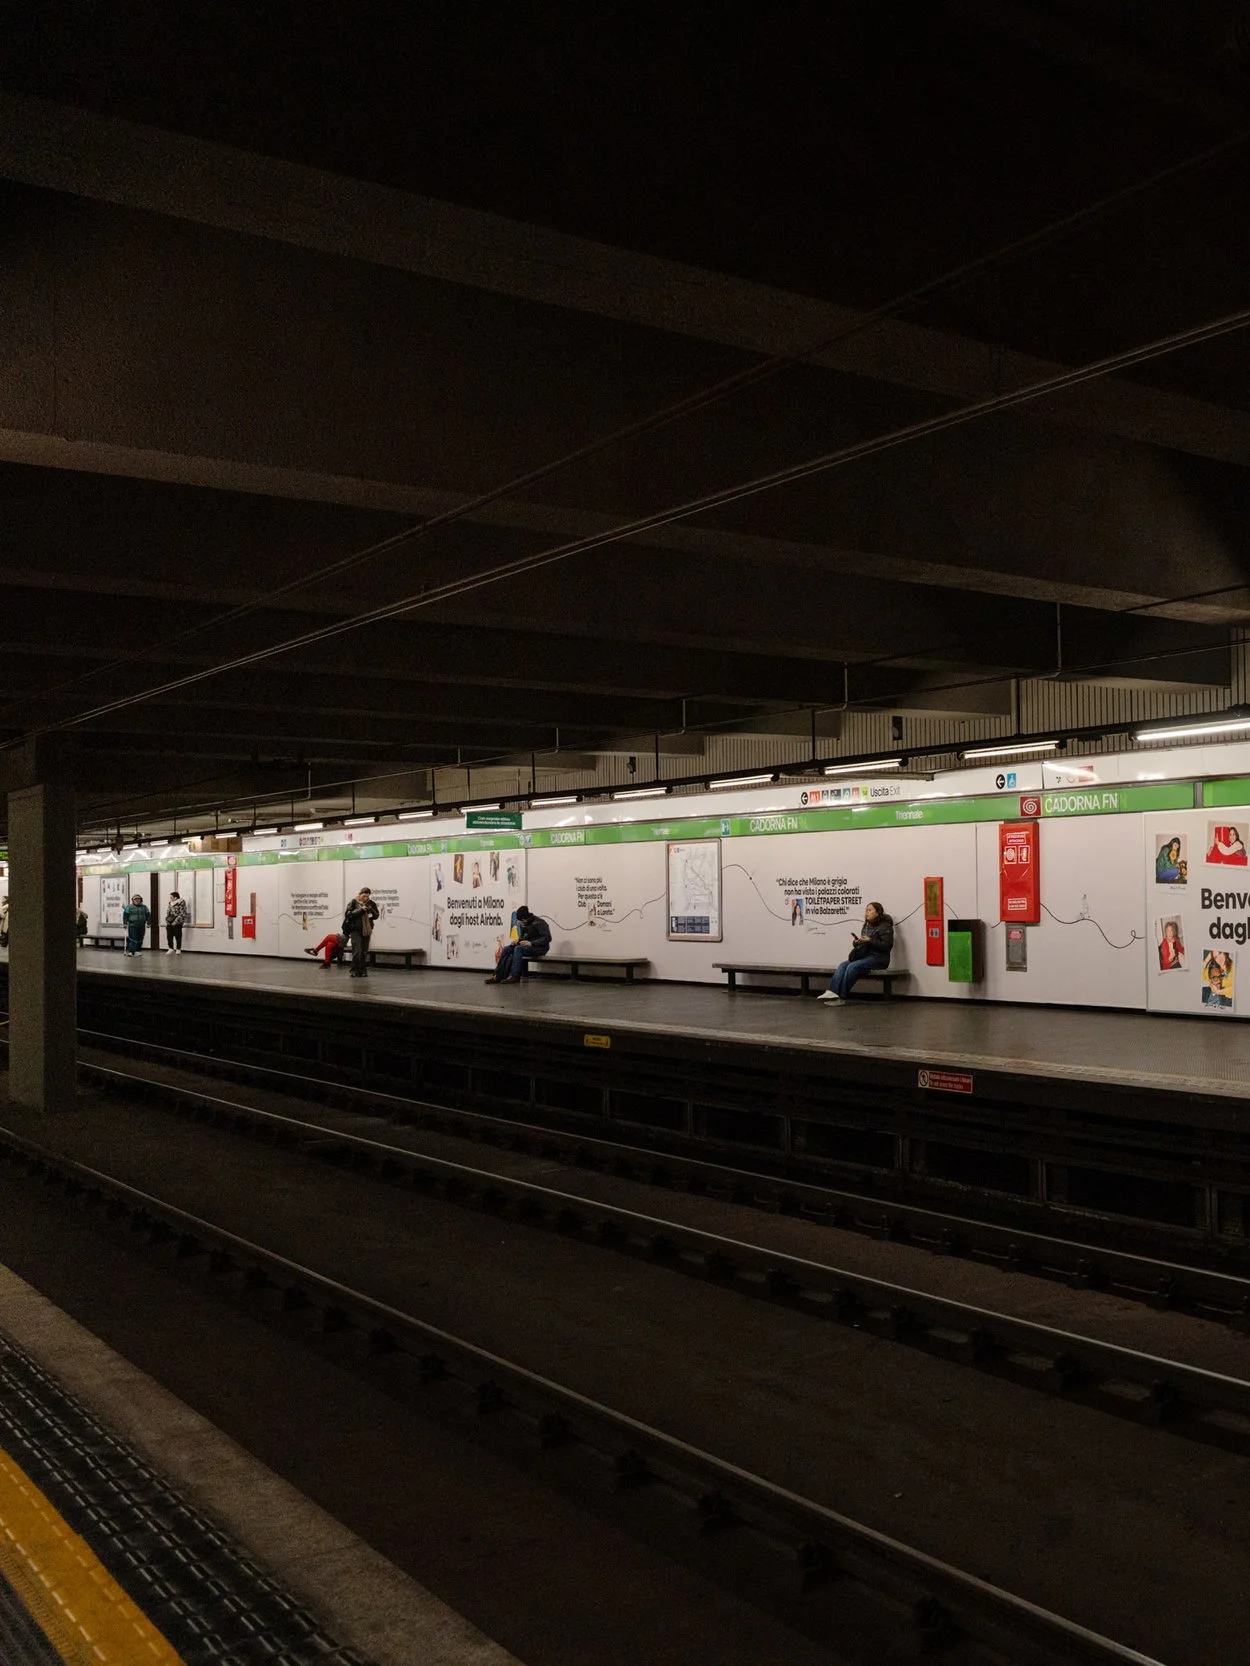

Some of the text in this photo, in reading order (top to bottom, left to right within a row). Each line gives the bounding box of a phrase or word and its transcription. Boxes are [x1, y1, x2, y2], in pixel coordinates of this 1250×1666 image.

[870, 786, 901, 798] Uscita Exit
[1044, 793, 1118, 813] CADORNA FN
[896, 810, 923, 821] Triennale
[749, 817, 798, 832] CADORNA FN
[788, 878, 799, 886] dice
[799, 878, 808, 886] che
[809, 877, 826, 886] Milano
[831, 876, 847, 887] grigia
[802, 887, 815, 895] visto
[818, 887, 837, 896] palazzi
[838, 886, 859, 894] colorati
[447, 896, 504, 909] Benvenuti a Milano
[585, 893, 597, 901] questo
[805, 897, 840, 905] TOILETPAPER
[841, 896, 862, 904] STREET
[811, 906, 819, 914] via
[819, 906, 849, 915] Balzaretti.”
[450, 913, 503, 928] dagli host Airbnb.
